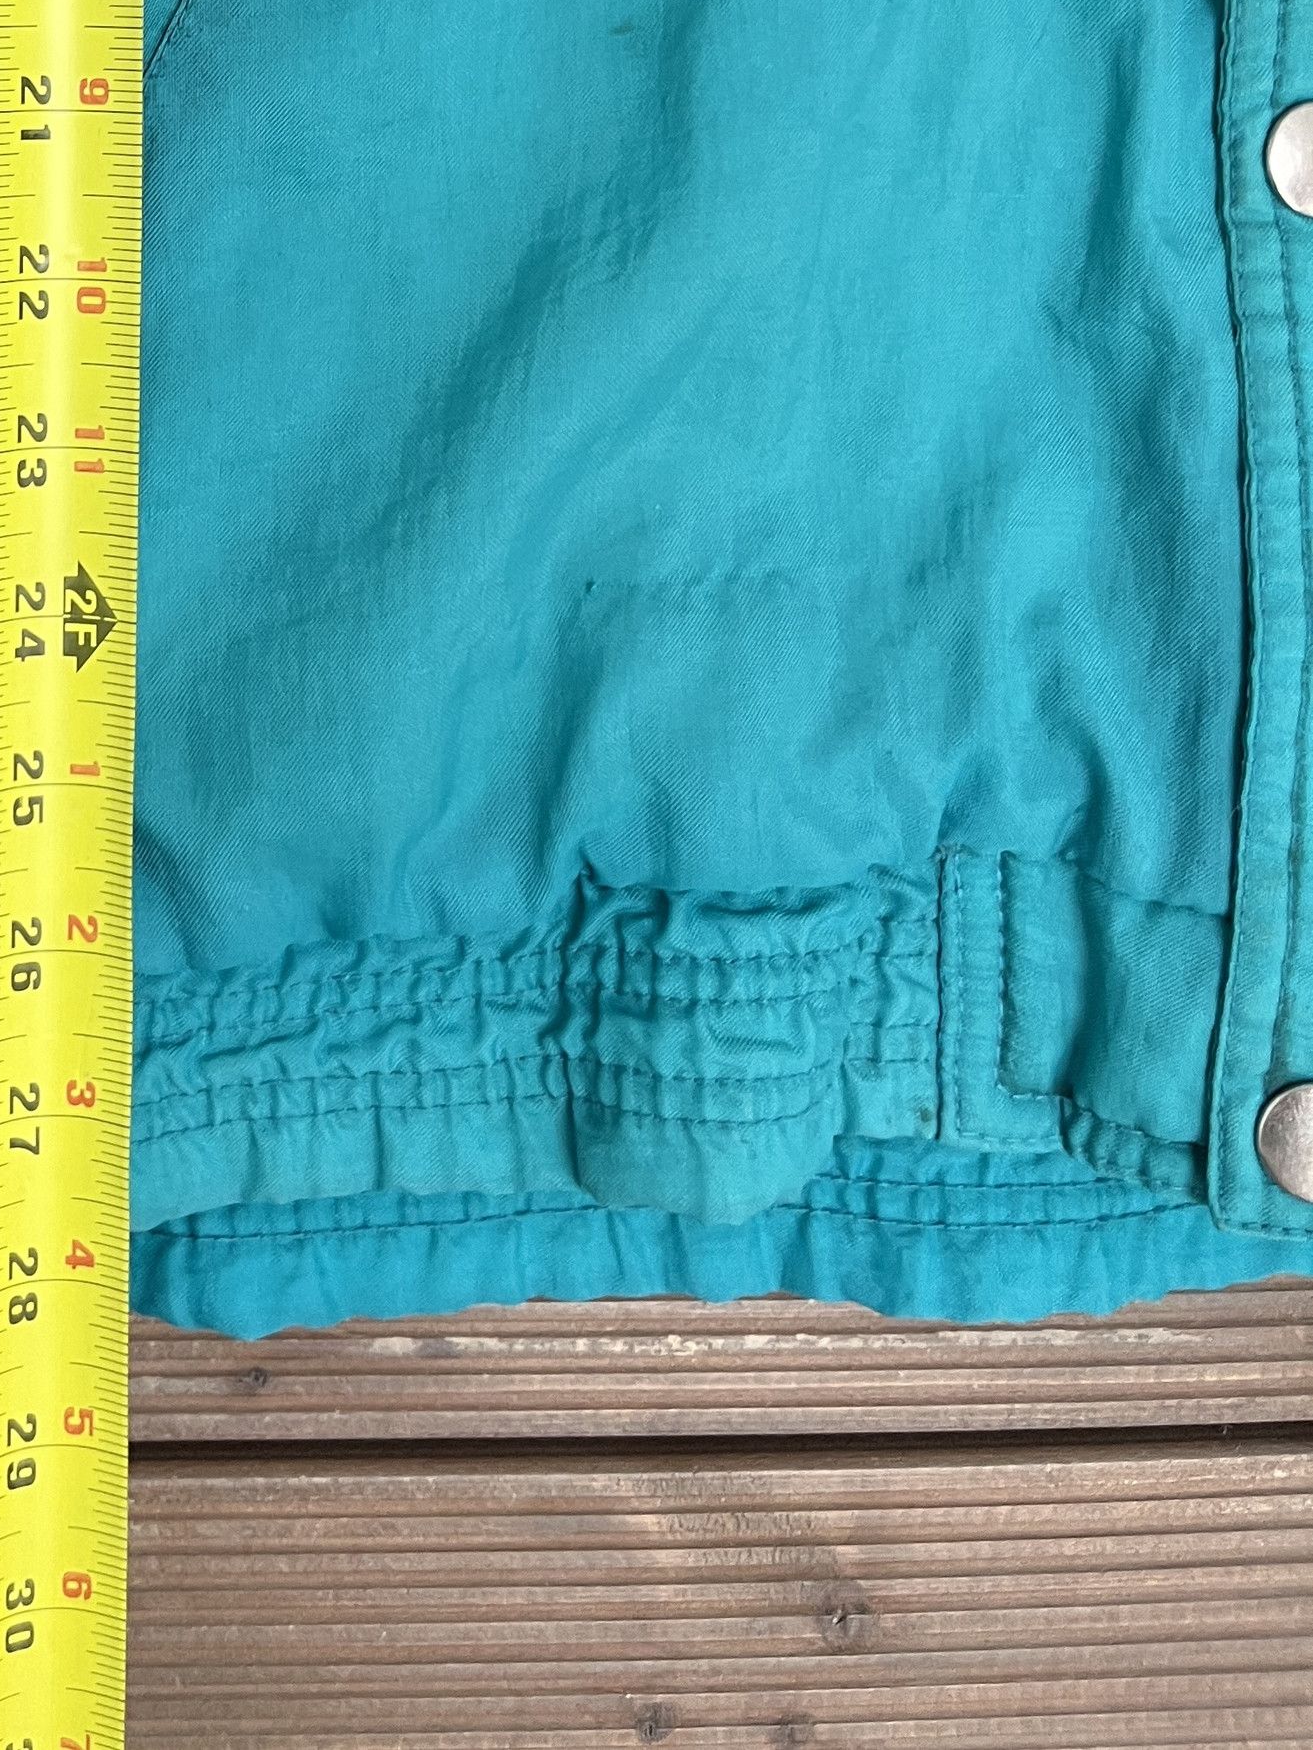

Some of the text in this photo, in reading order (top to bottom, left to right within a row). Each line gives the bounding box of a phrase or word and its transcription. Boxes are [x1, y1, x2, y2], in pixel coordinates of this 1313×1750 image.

[19, 74, 52, 142] 21
[77, 77, 110, 107] 9
[17, 243, 51, 321] 22
[75, 257, 109, 316] 10
[15, 412, 49, 490] 23
[73, 424, 106, 475] 11
[13, 581, 46, 663] 24
[12, 749, 45, 827] 25
[69, 761, 101, 779] 1
[10, 916, 42, 993] 26
[67, 913, 99, 944] 2
[8, 1081, 40, 1157] 27
[65, 1079, 96, 1109] 3
[6, 1247, 38, 1326] 28
[64, 1238, 95, 1271] 4
[5, 1412, 37, 1490] 29
[62, 1405, 94, 1438] 5
[3, 1577, 35, 1654] 30
[60, 1570, 92, 1601] 6
